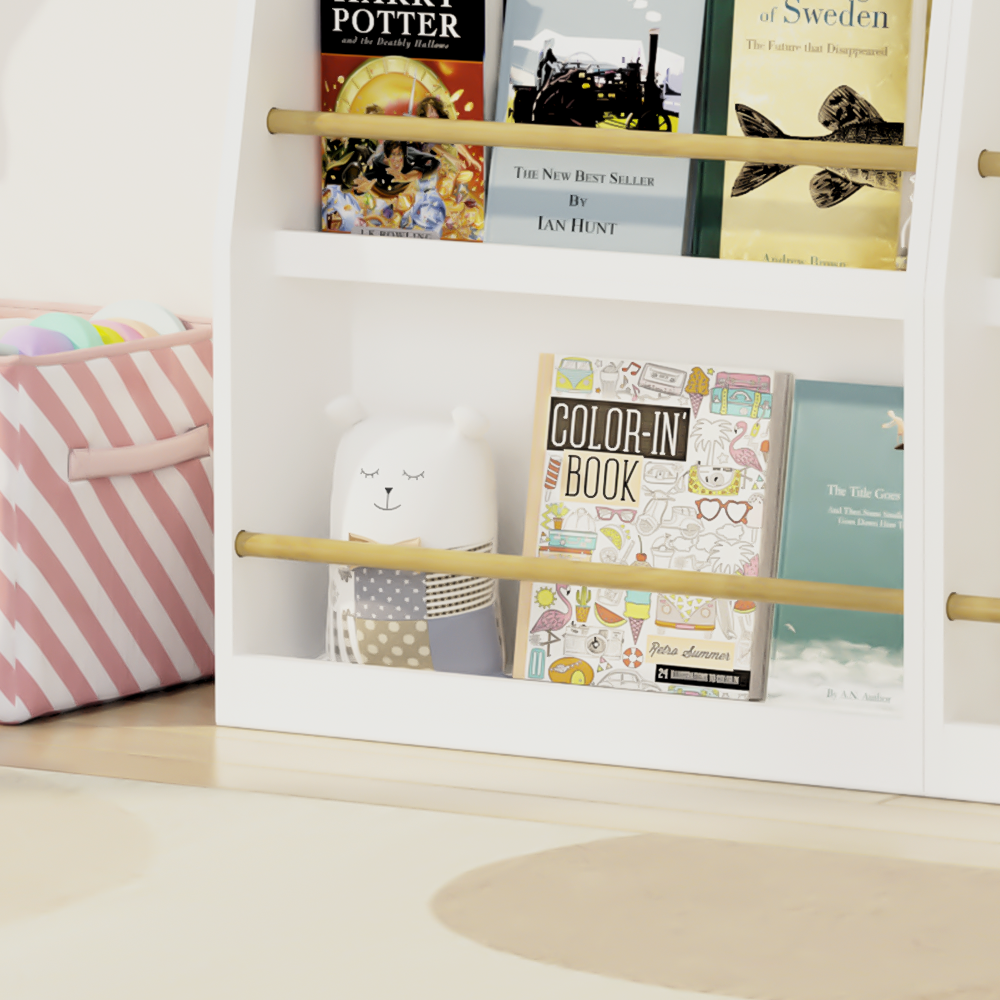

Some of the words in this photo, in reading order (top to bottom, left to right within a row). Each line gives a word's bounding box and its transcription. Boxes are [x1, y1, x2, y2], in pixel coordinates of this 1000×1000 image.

[332, 7, 461, 39] POTTER
[759, 7, 778, 23] of
[341, 36, 358, 44] and
[360, 37, 373, 45] the
[377, 37, 411, 49] Deathly
[414, 39, 450, 49] Hallows
[746, 39, 765, 51] The
[768, 40, 801, 52] Future
[804, 42, 823, 53] that
[827, 43, 888, 58] Disappeared
[565, 454, 640, 503] BOOK
[826, 484, 847, 497] The
[849, 486, 872, 499] Title
[874, 488, 902, 501] Goes
[649, 641, 678, 658] Retro
[681, 645, 731, 661] Summer
